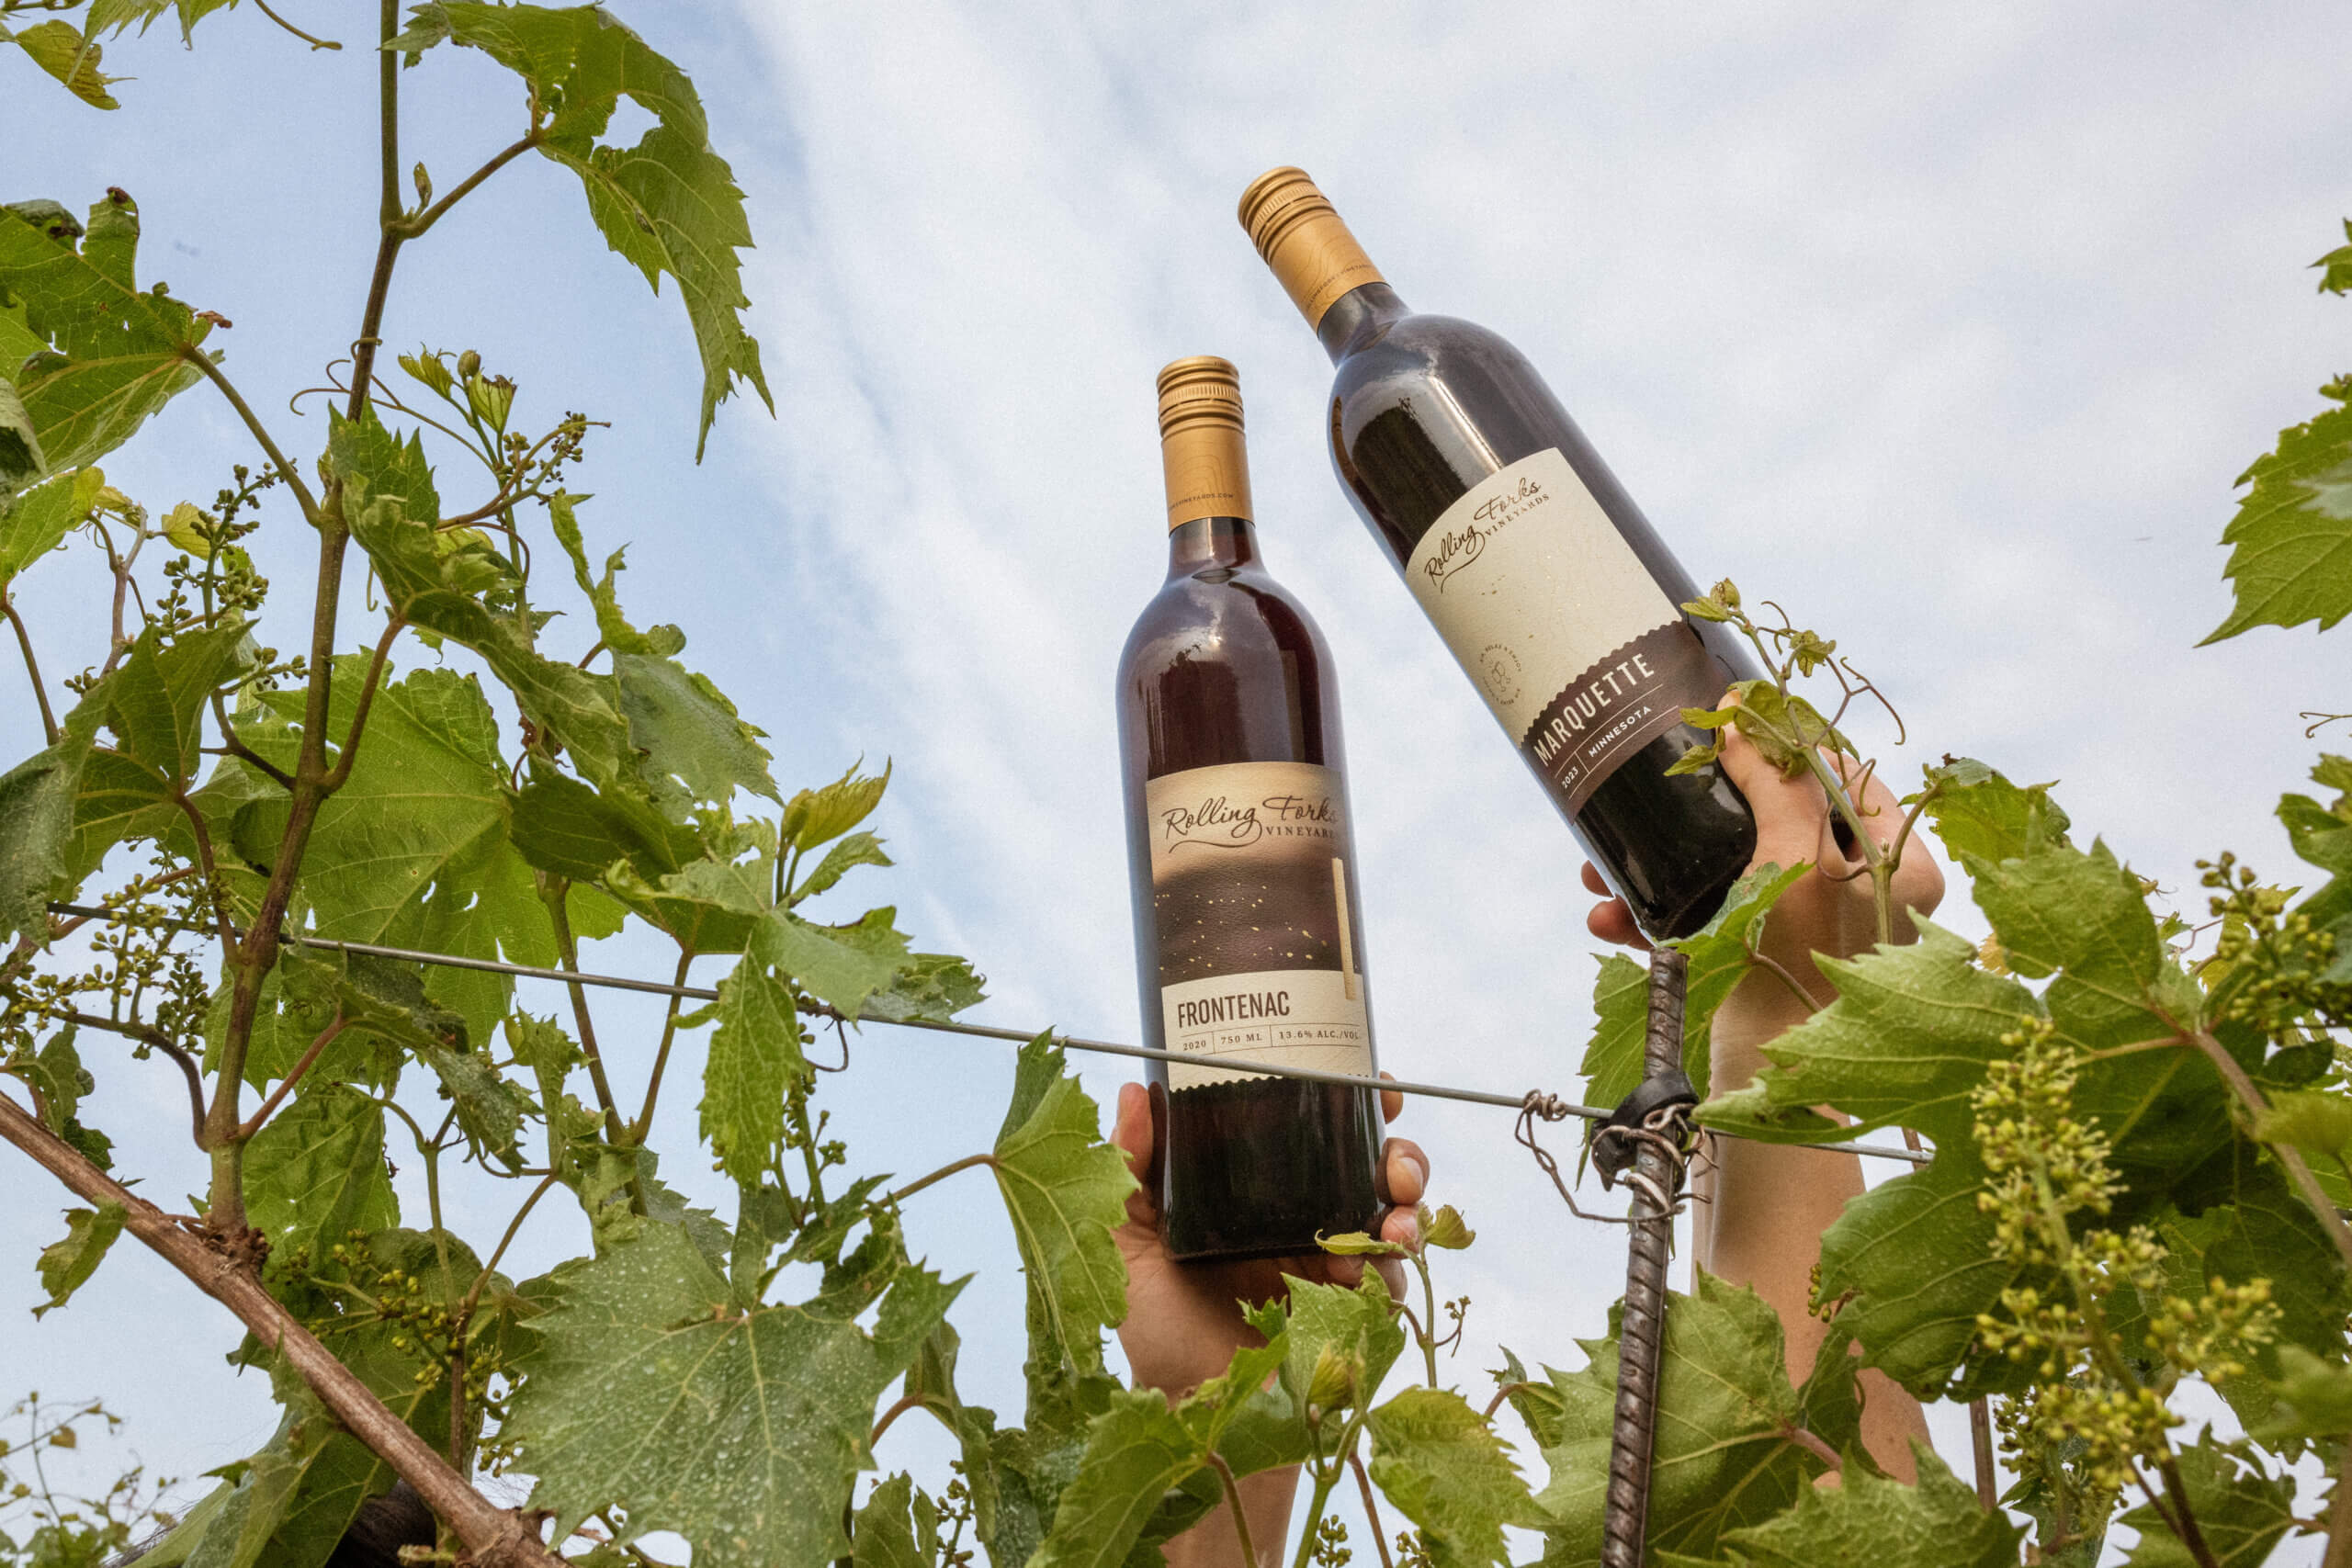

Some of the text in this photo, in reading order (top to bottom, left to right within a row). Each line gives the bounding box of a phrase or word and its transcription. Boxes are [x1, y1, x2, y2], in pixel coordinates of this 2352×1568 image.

[1424, 477, 1542, 593] Rolling Forks
[1485, 493, 1550, 536] VINEYARDS
[1532, 653, 1655, 767] MARQUETTE
[1561, 705, 1652, 789] 2023 MINNESOTA
[1161, 795, 1263, 853] Rolling
[1178, 990, 1291, 1029] FRONTENAC
[1182, 1040, 1206, 1051] 2020
[1220, 1034, 1241, 1045] 750
[1246, 1033, 1262, 1043] ML
[1278, 1030, 1313, 1041] 13.6%
